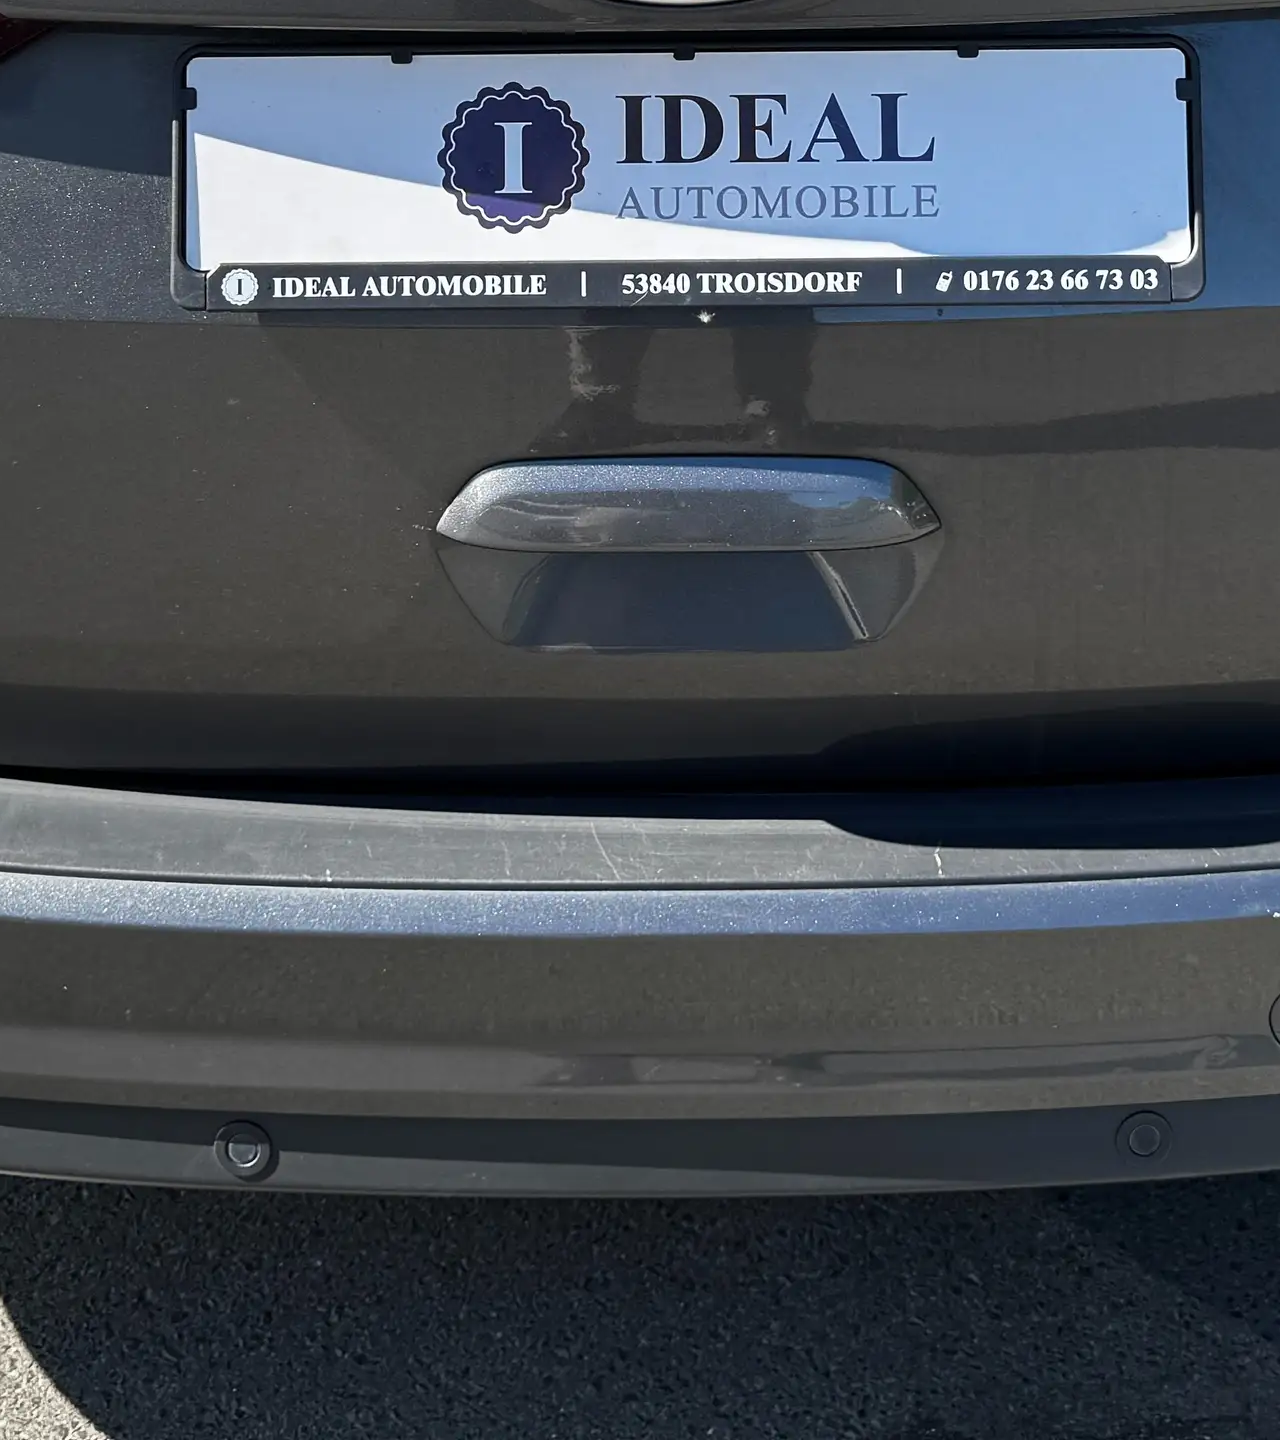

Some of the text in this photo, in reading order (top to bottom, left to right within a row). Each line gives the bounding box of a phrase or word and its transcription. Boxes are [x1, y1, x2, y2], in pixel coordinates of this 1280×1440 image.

[615, 92, 937, 164] IDEAL
[616, 184, 941, 220] AUTOMOBILE
[272, 268, 1159, 298] IDEAL AUTOMOBILE 53840 TROISDORF 0176 23 66 73 03
